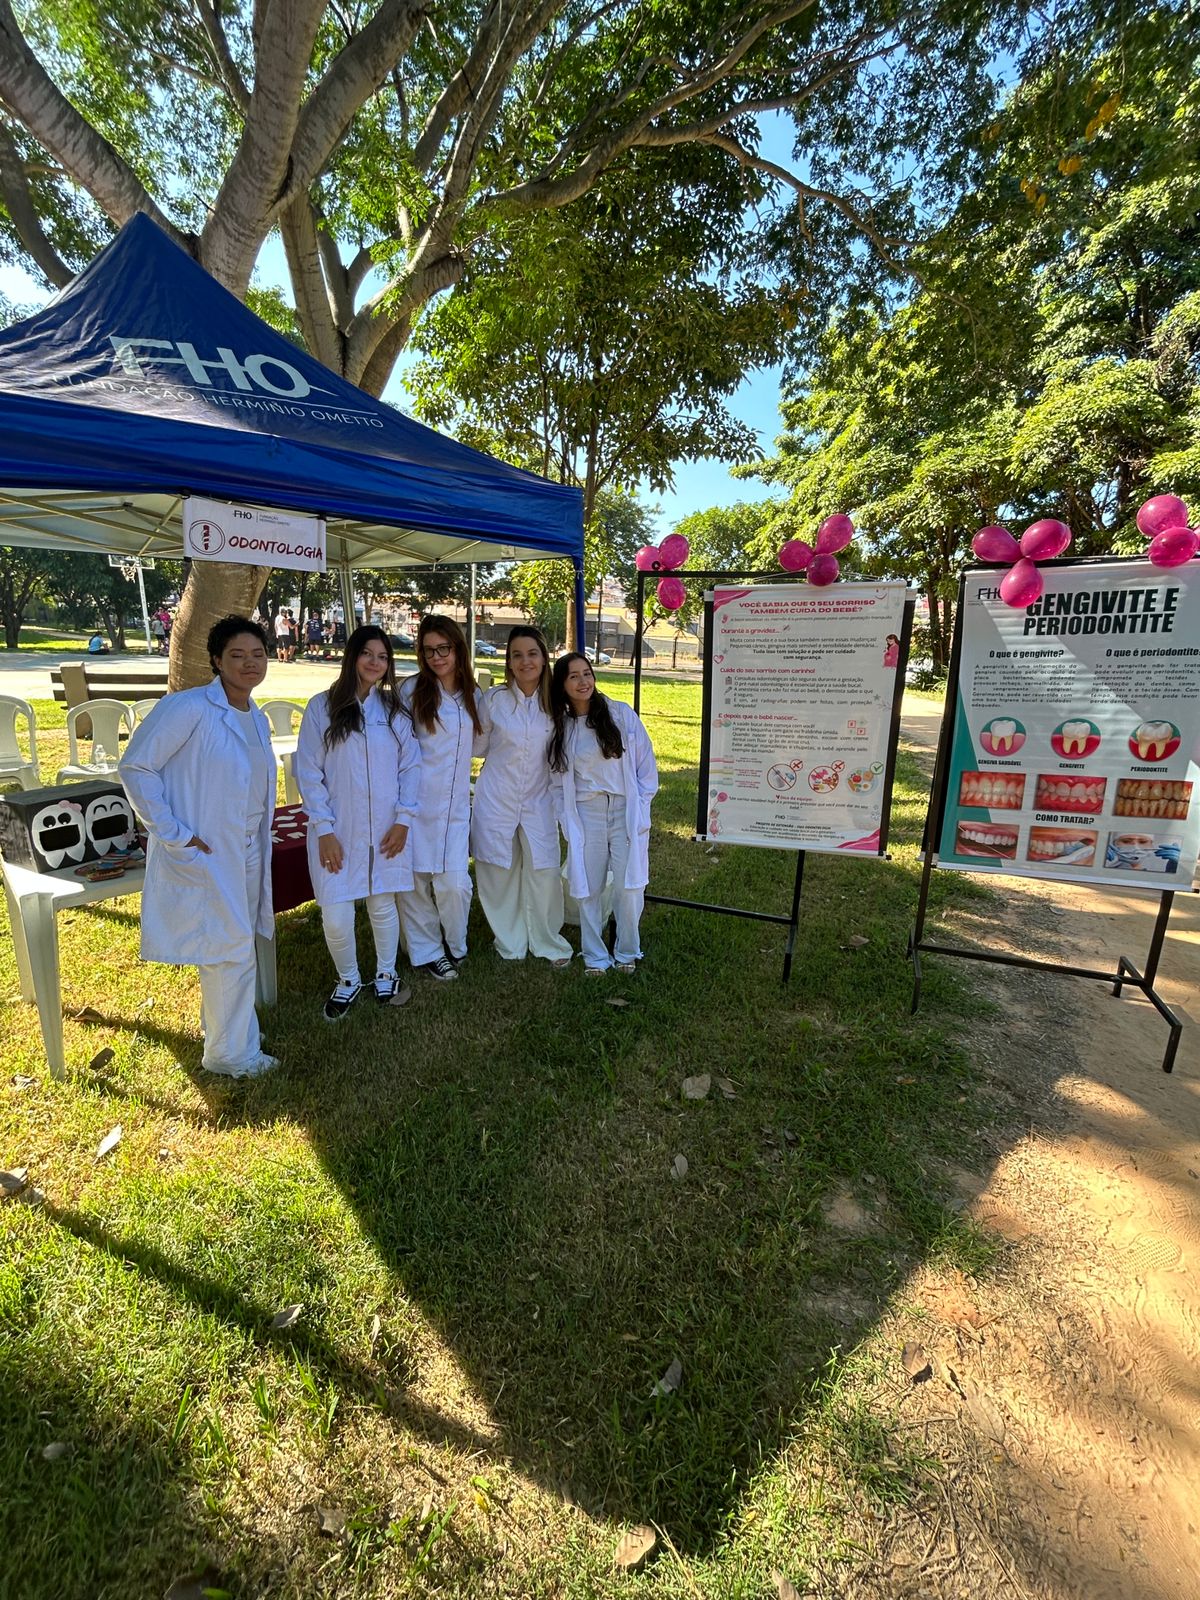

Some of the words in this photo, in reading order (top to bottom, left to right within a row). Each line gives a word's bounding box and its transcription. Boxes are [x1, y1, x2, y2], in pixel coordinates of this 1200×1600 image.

[109, 336, 311, 398] FHO
[311, 410, 384, 428] OMETTO
[233, 509, 252, 520] FHO
[228, 536, 323, 560] ODONTOLOGIA
[978, 587, 1002, 599] FH
[1026, 589, 1158, 617] GENGIVITE
[1163, 588, 1180, 612] E
[1023, 613, 1175, 636] PERIODONTITE
[990, 650, 995, 658] O
[996, 651, 1011, 659] que
[1020, 649, 1064, 659] gengivite?
[1106, 648, 1112, 657] O
[1114, 649, 1131, 658] que
[1133, 648, 1139, 656] é
[1035, 814, 1058, 822] COMO
[1060, 816, 1095, 825] TRATAR?
